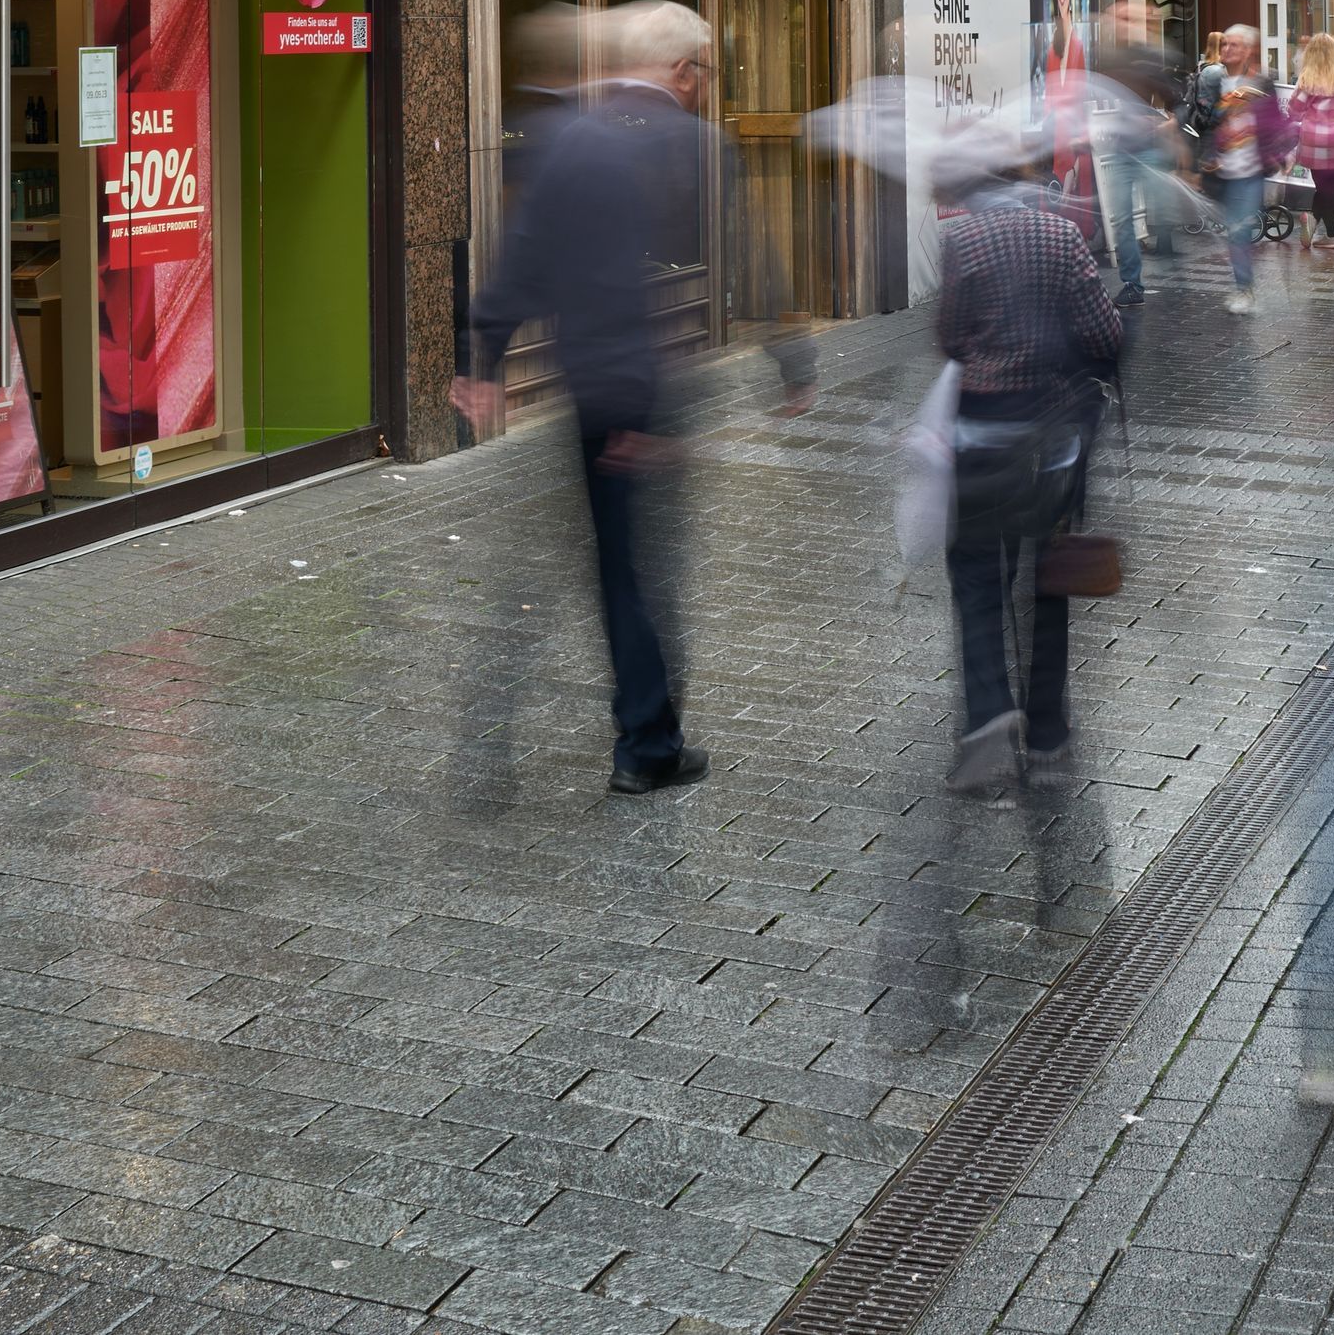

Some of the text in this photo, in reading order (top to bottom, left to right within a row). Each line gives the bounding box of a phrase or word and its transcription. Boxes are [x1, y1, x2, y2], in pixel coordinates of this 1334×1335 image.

[288, 17, 338, 27] Finden Sie uns auf
[280, 30, 345, 50] yves-rocher.de
[935, 33, 979, 66] BRIGHT
[935, 74, 962, 108] LIKE
[965, 73, 973, 105] A
[132, 109, 173, 135] SALE
[105, 147, 197, 210] -50%
[111, 227, 124, 238] AUF
[166, 220, 198, 232] PRODUKTE
